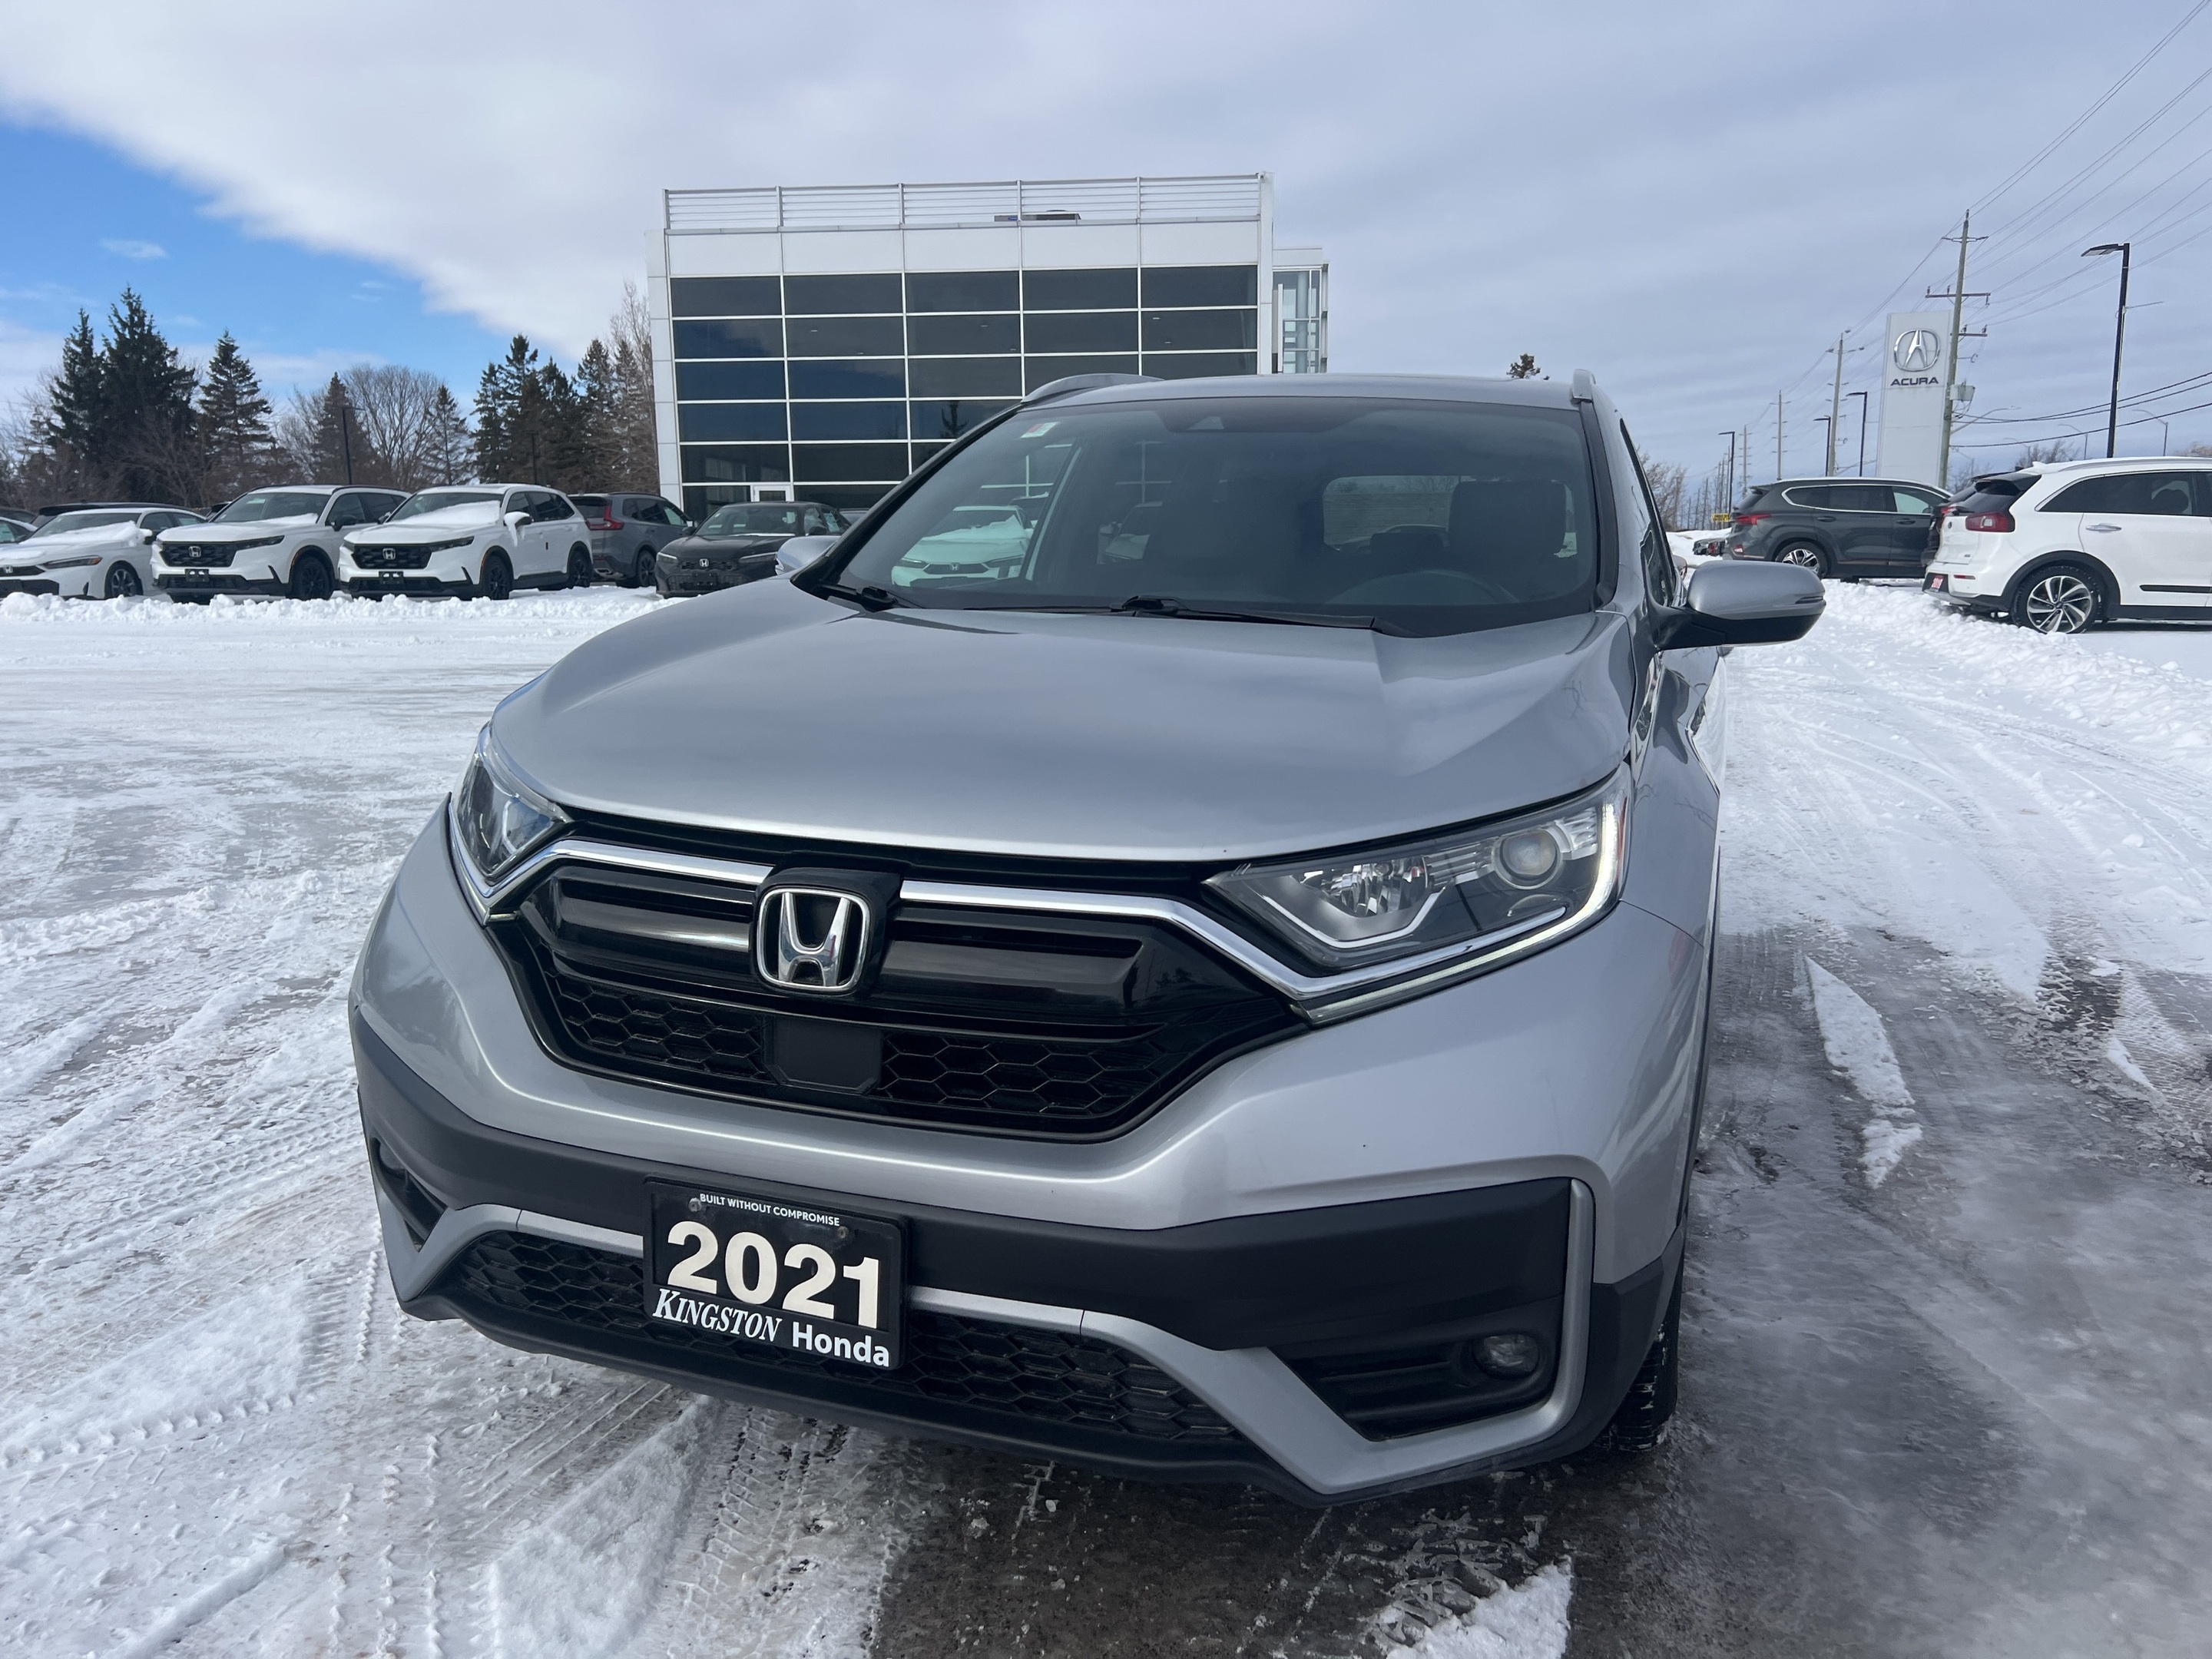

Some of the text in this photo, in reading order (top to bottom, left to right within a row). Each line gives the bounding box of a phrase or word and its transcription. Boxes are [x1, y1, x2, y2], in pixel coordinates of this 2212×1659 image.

[1890, 376, 1939, 386] ACURA
[700, 1193, 840, 1227] BUILT WITHOUT COMPROMISE
[667, 1220, 879, 1330] 2021
[652, 1288, 890, 1368] KINGSTON Honda
